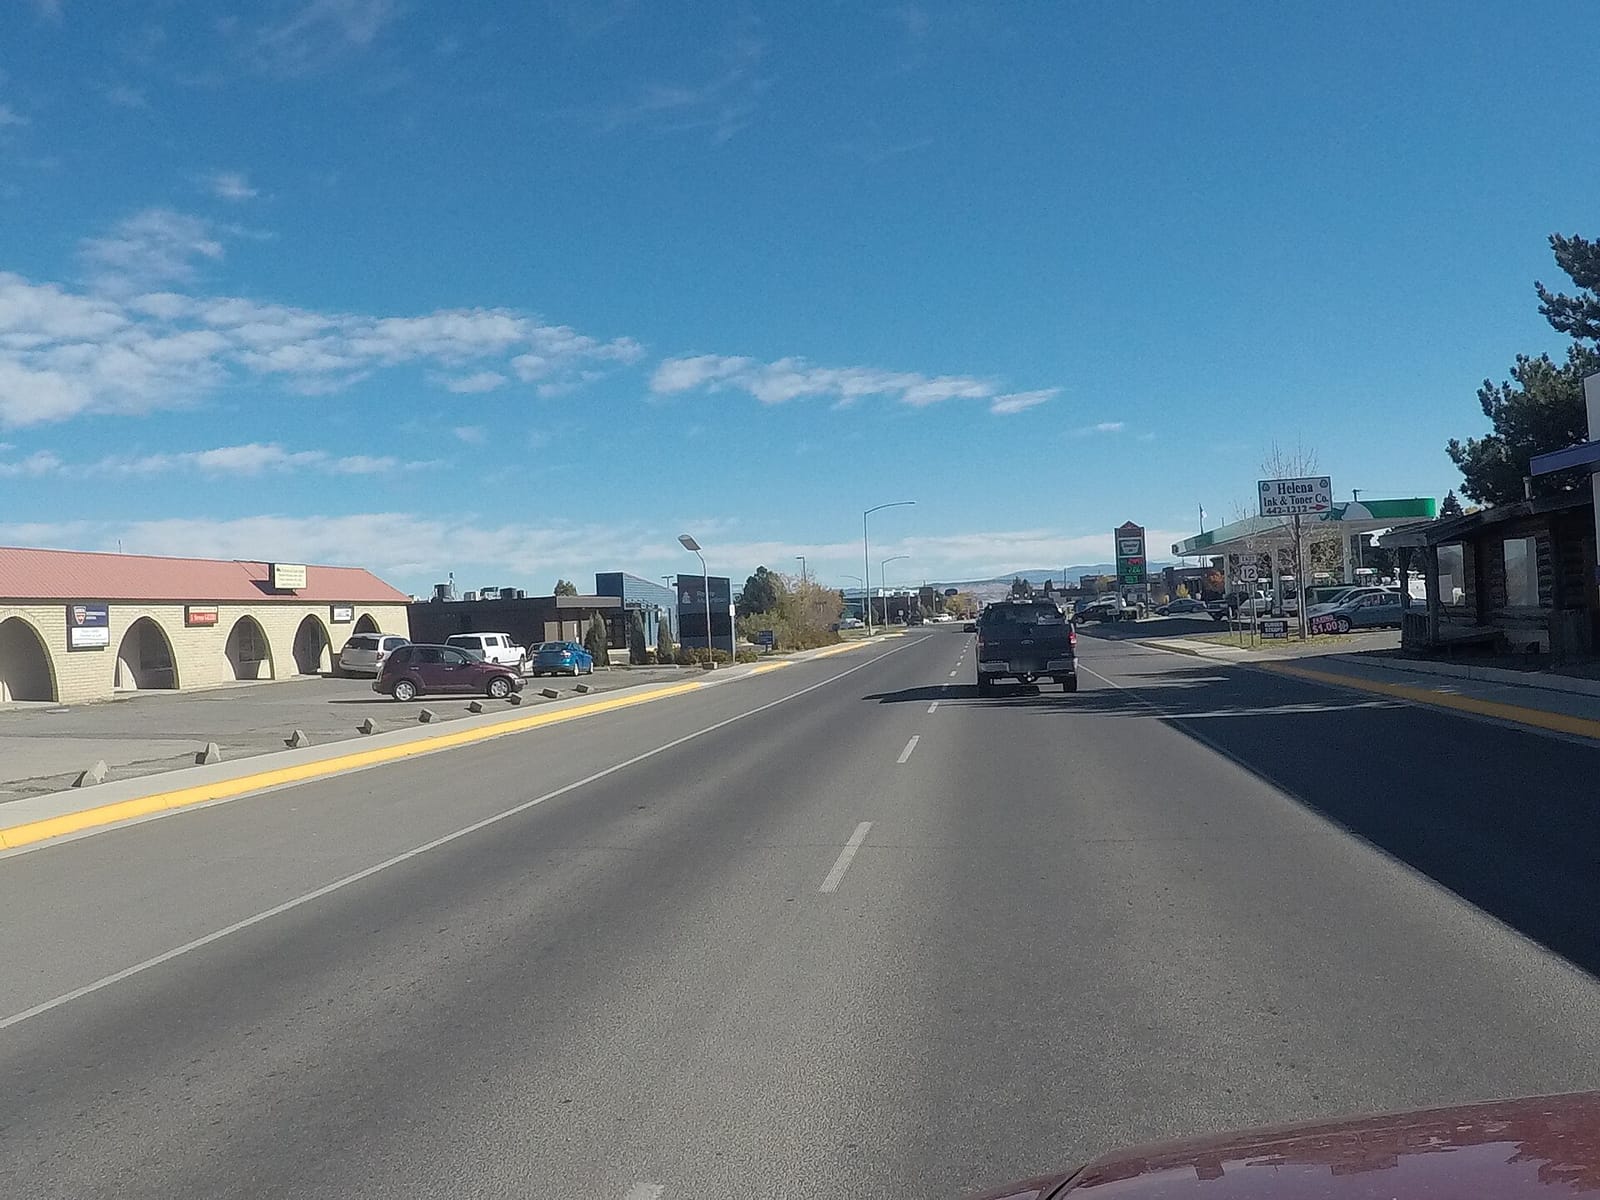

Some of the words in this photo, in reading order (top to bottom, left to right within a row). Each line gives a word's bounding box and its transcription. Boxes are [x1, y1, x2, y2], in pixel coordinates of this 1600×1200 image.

[1278, 482, 1313, 495] Helena
[1264, 497, 1278, 507] Ink
[1280, 496, 1288, 506] &
[1289, 495, 1313, 505] Toner
[1315, 493, 1328, 503] Co.
[1244, 568, 1255, 578] 12
[1312, 620, 1338, 634] $1.00
